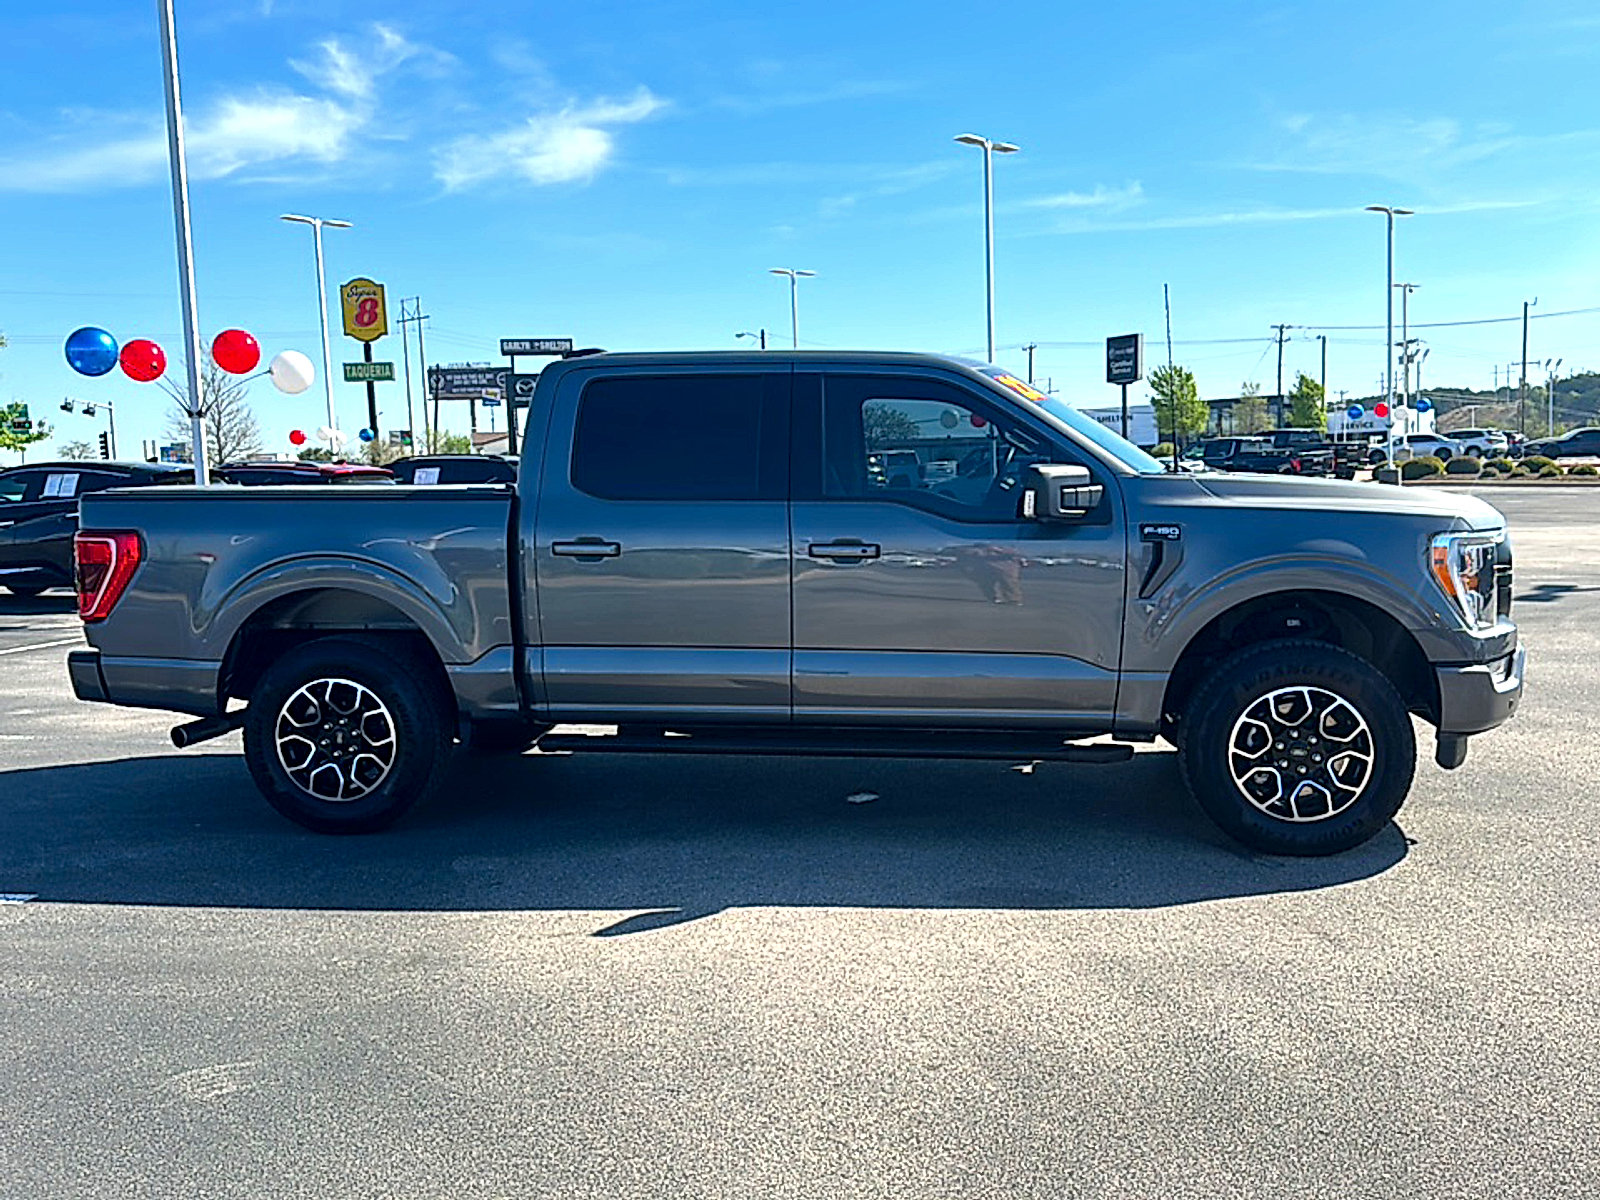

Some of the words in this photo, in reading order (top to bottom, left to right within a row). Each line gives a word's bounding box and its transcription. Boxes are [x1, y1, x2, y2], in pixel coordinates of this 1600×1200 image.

[347, 285, 377, 303] Super
[354, 298, 378, 328] 8
[345, 364, 392, 378] TAQUERIA
[1097, 415, 1133, 423] SHELTN
[1143, 526, 1180, 535] F-150
